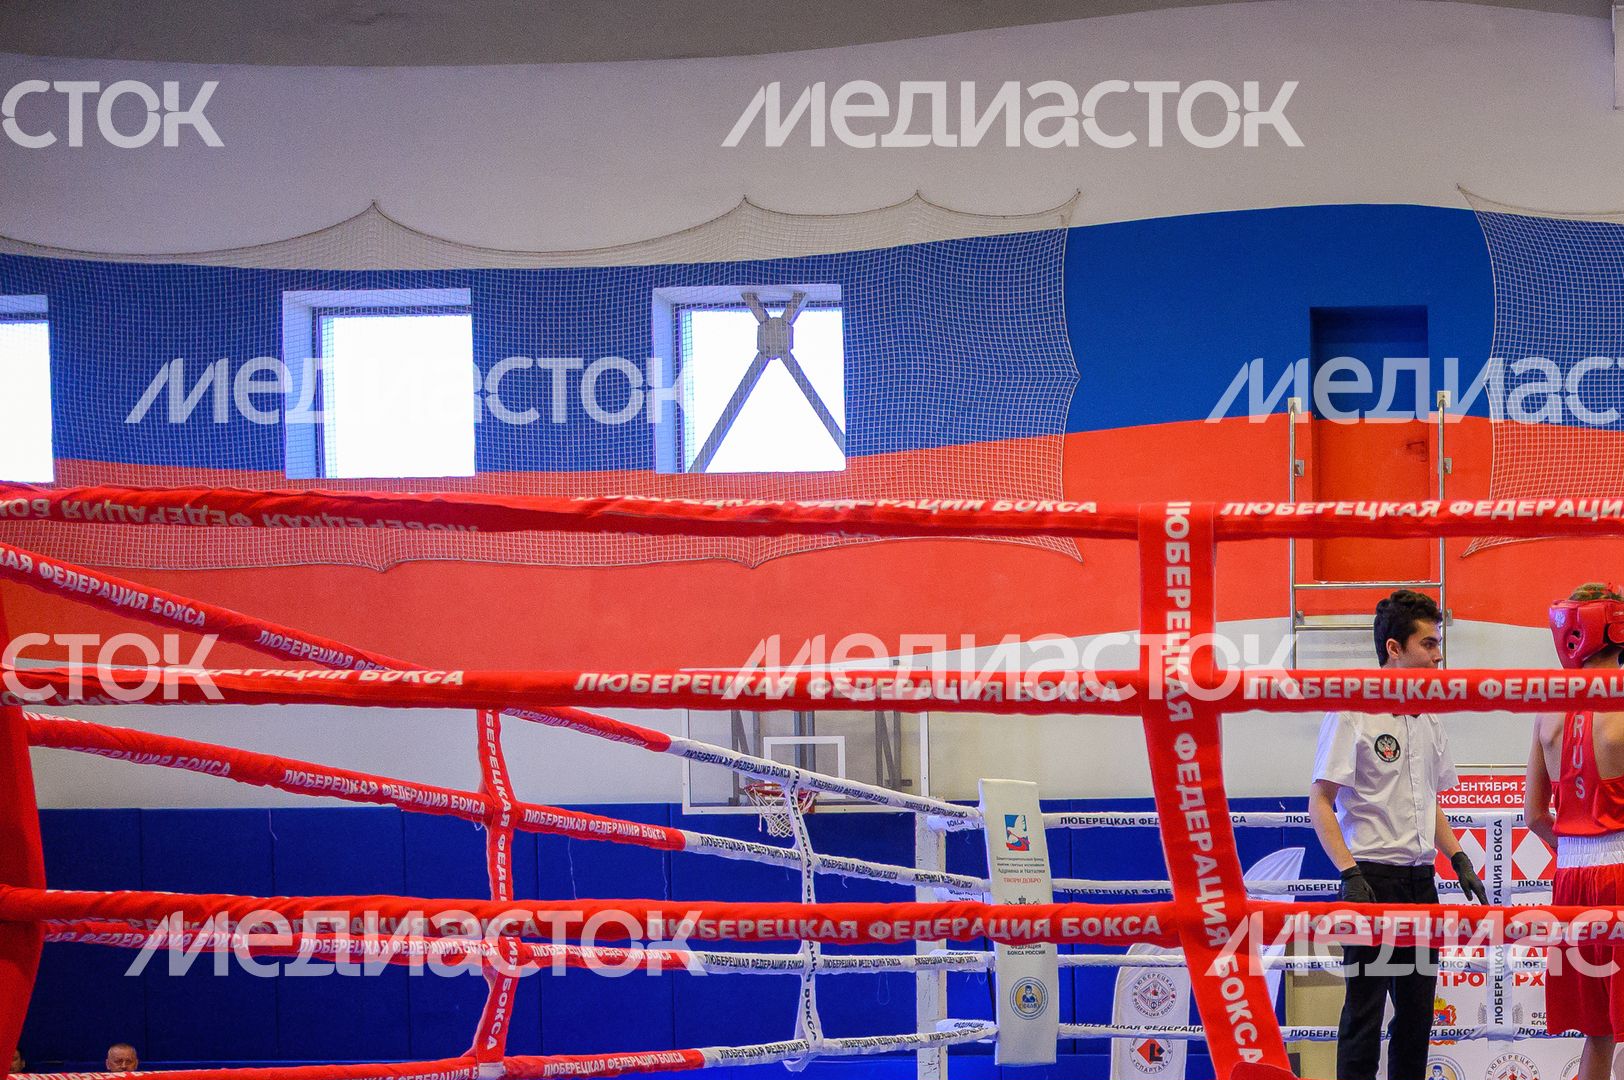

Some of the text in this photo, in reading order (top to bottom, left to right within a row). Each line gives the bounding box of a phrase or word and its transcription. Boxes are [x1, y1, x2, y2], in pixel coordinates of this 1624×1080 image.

[1218, 499, 1443, 518] ЛЮБЕРЕЦКАЯ
[38, 562, 206, 626] ФЕДЕРАЦИЯ БОКСА
[255, 629, 354, 669] ЛЮБЕРЕЦКАЯ
[574, 673, 1119, 704] ЛЮБЕРЕЦКАЯ ФЕДЕРАЦИЯ БОКСА
[1245, 677, 1468, 704] ЛЮБЕРЕЦКАЯ
[281, 769, 486, 816] ЛЮБЕРЕЦКАЯ ФЕДЕРАЦИЯ БОКСА
[1452, 782, 1518, 792] СЕНТЯБРЯ
[524, 809, 640, 838] ЛЮБЕРЕЦКАЯ ФЕДЕРАЦИЯ
[1060, 816, 1135, 826] ЛЮБЕРЕЦКАЯ
[1174, 733, 1231, 947] ФЕДЕРАЦИЯ
[1493, 819, 1503, 861] БОКСА
[648, 915, 1162, 940] ЛЮБЕРЕЦКАЯ ФЕДЕРАЦИЯ БОКСА
[1281, 912, 1495, 940] ЛЮБЕРЕЦКАЯ
[297, 937, 389, 956] ЛЮБЕРЕЦКАЯ
[704, 954, 749, 967] ЛЮБЕРЕЦКАЯ
[543, 1052, 685, 1078] ЛЮБЕРЕЦКАЯ ФЕДЕРАЦИЯ БОКСА
